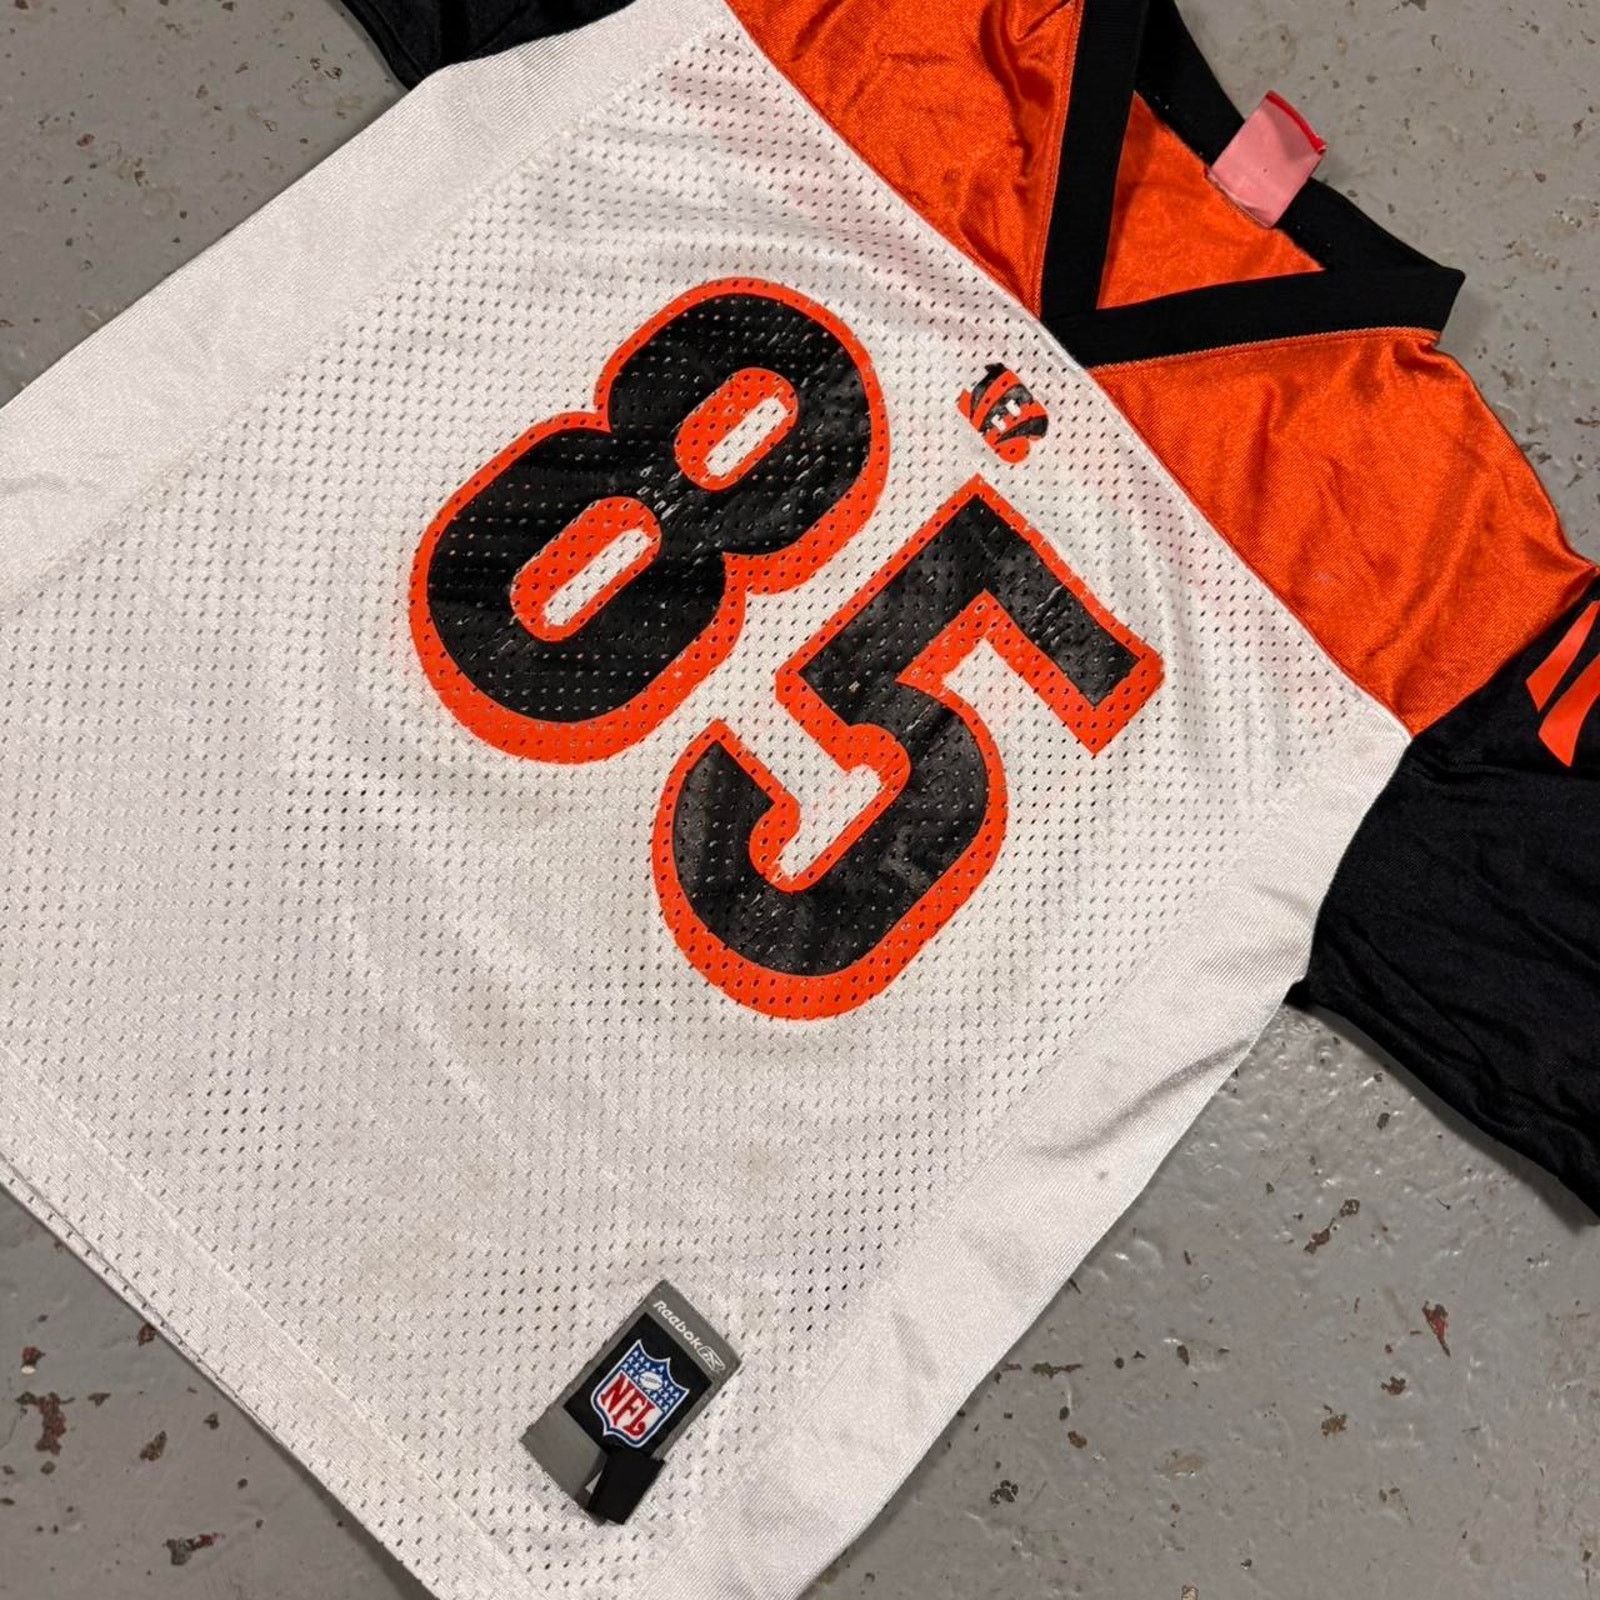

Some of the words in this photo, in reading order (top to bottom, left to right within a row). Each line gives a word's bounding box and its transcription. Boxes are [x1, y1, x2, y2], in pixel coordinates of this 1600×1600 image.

[409, 277, 1164, 1019] 85
[653, 1300, 703, 1351] Reebok
[600, 1373, 655, 1436] NFL
